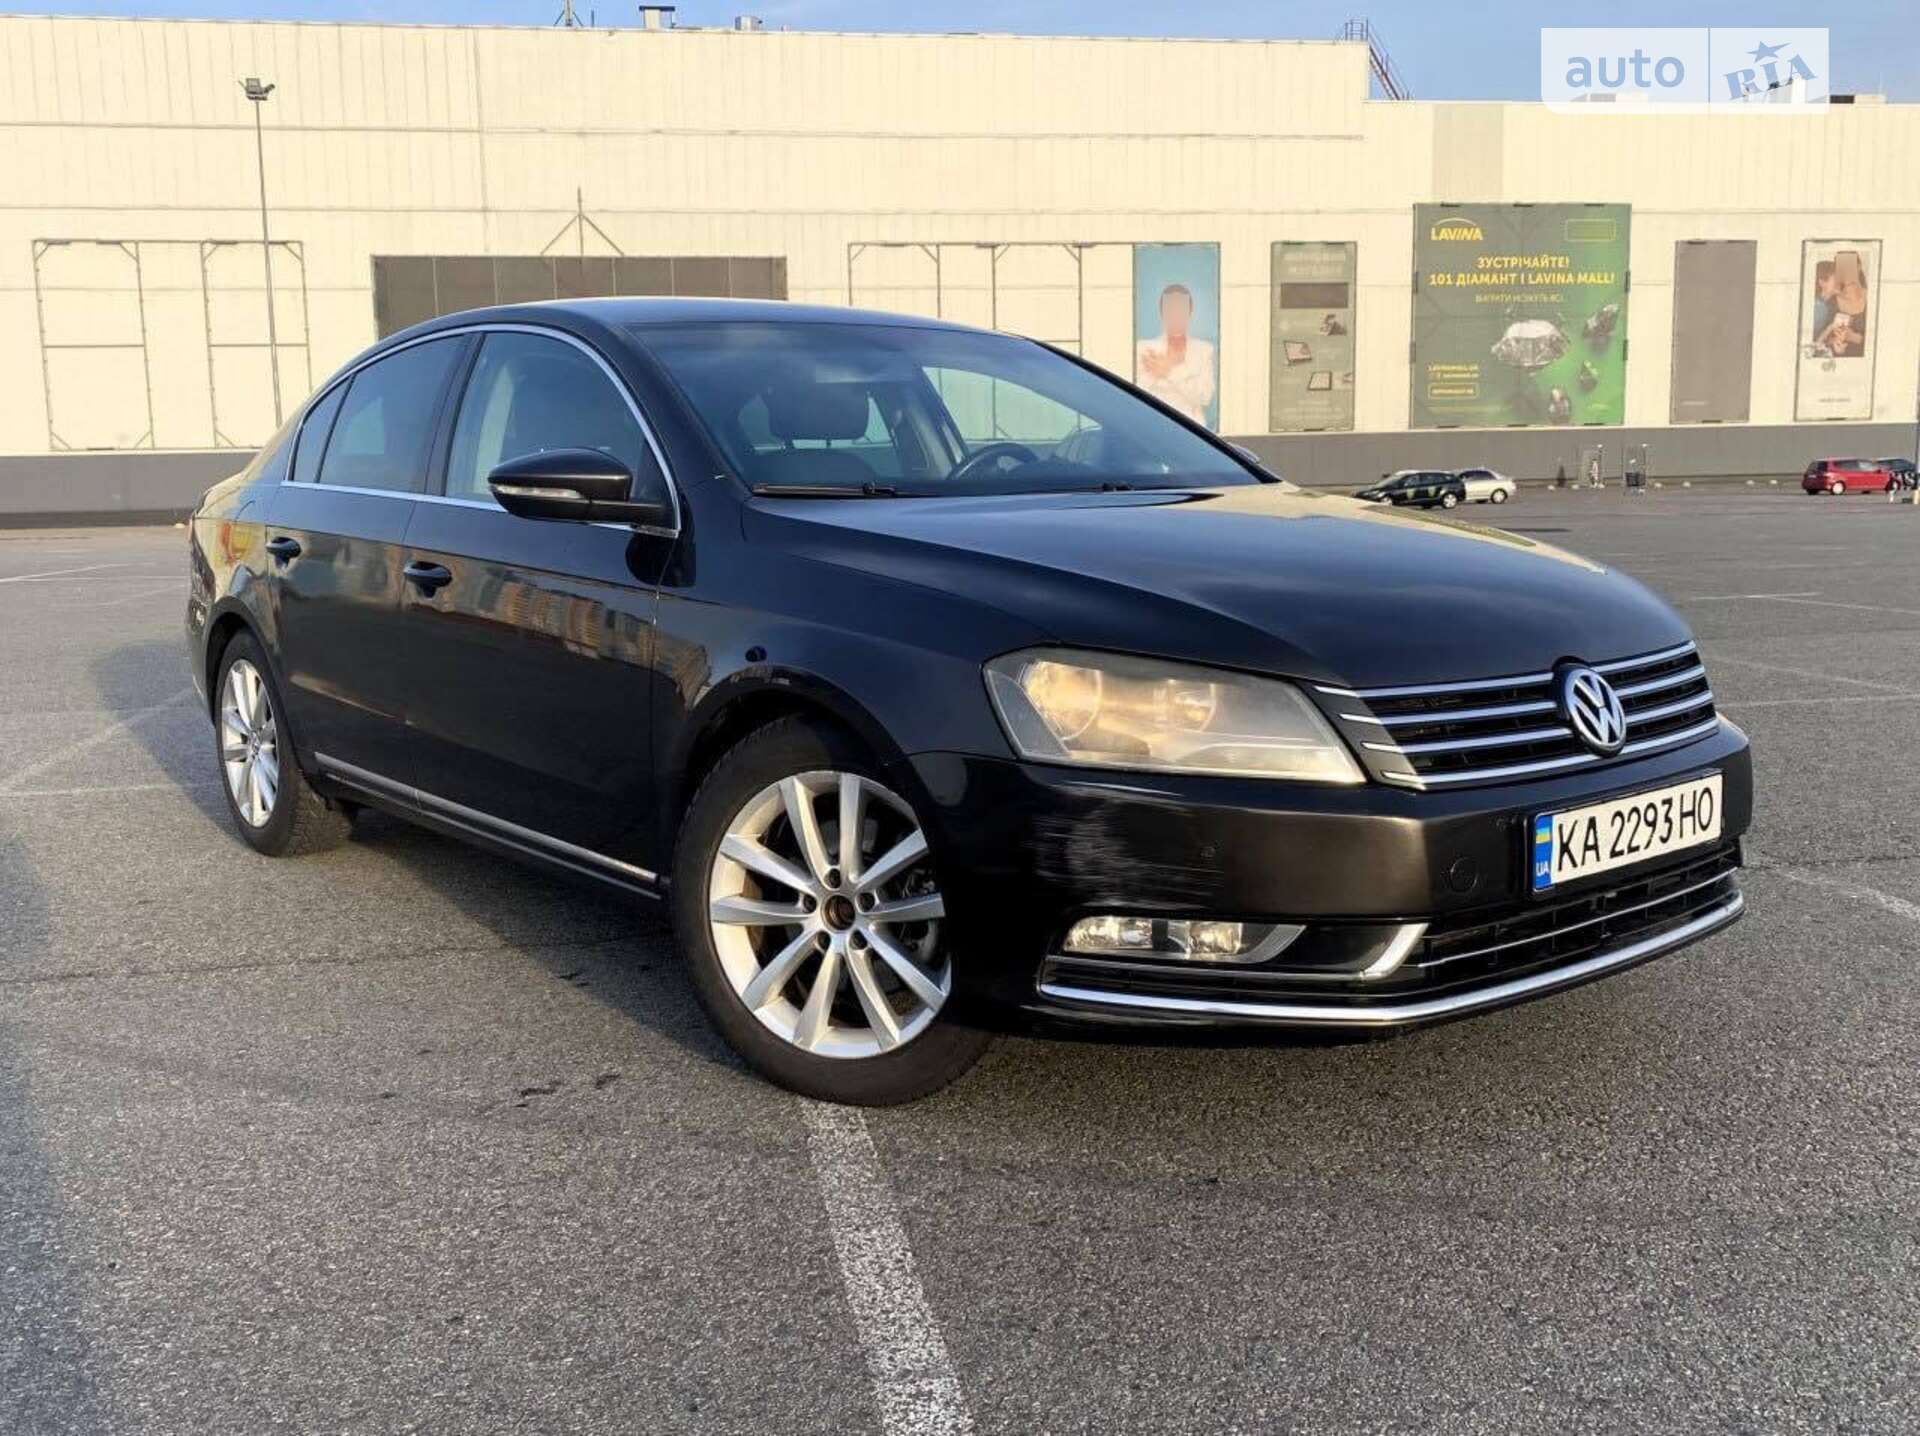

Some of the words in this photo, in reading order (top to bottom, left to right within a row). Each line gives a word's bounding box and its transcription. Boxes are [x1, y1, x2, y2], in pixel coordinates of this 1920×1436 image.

[1431, 227, 1483, 240] LAVINA
[1477, 254, 1569, 269] ЗУСТРІЧАЙТЕ!
[1430, 274, 1452, 285] 101
[1455, 273, 1517, 287] ДІАМАНТ
[1528, 272, 1574, 285] LAVINA
[1576, 272, 1615, 284] MALL!
[1558, 816, 1601, 873] KA
[1609, 798, 1673, 859] 2293
[1679, 787, 1713, 839] HO
[1536, 862, 1550, 877] UA
